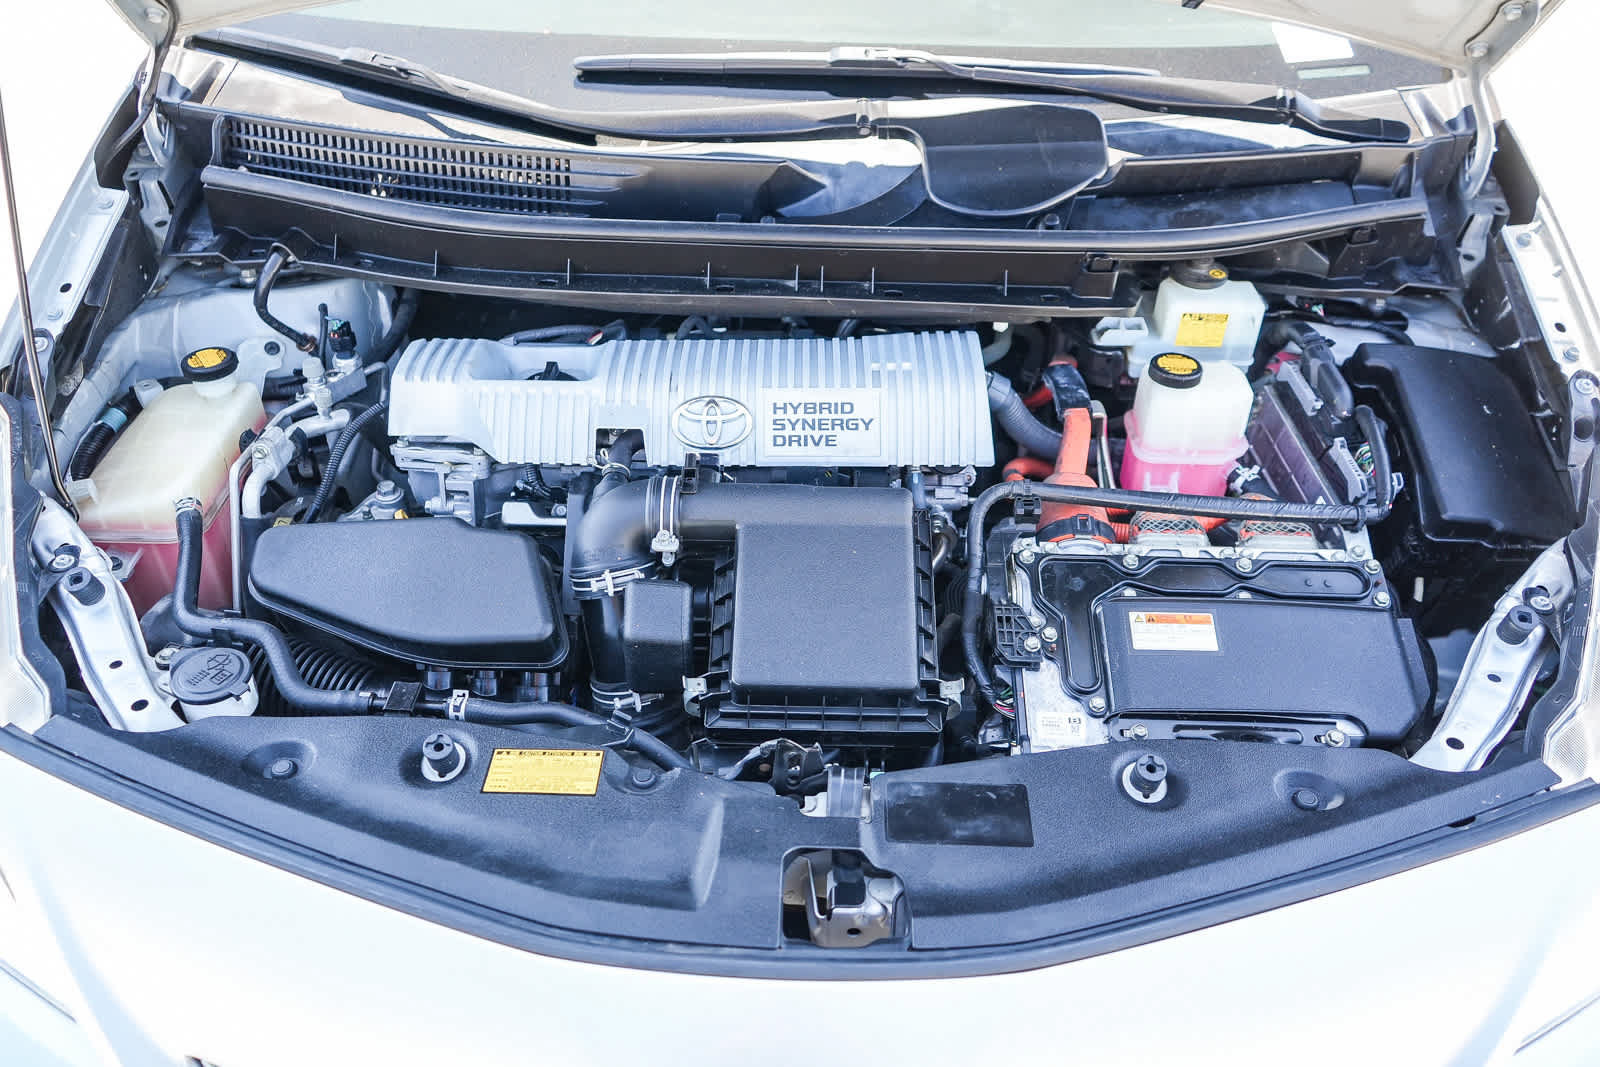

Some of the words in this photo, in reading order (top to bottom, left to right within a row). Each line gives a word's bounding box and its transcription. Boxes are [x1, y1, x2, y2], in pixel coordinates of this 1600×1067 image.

[772, 402, 854, 415] HYBRID
[772, 418, 874, 431] SYNERGY
[772, 434, 838, 447] DRIVE
